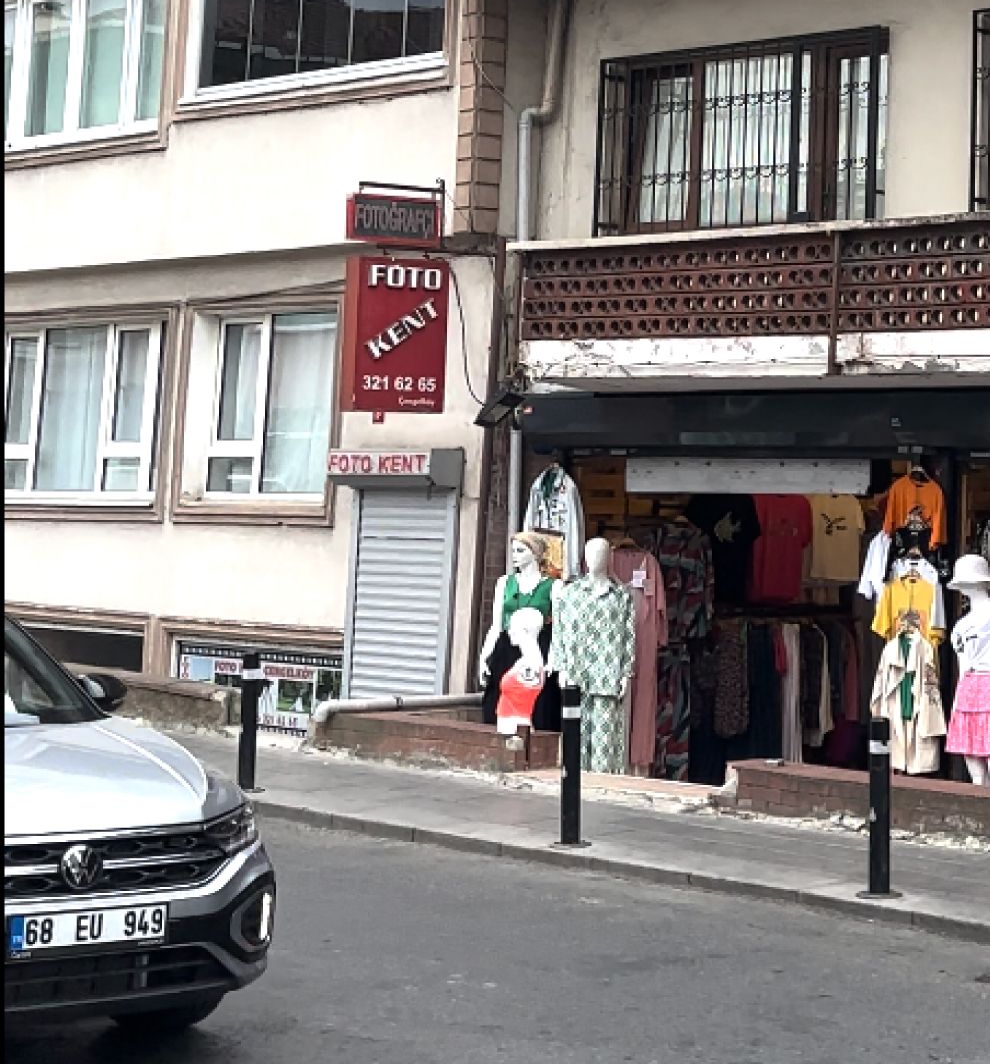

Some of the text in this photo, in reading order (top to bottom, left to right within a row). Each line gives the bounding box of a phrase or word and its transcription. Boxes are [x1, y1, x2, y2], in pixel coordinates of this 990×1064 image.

[368, 264, 442, 290] FOTO
[364, 297, 438, 359] KENT
[363, 374, 437, 393] 321 62 65
[328, 454, 426, 473] FOTO KENT
[26, 908, 163, 945] 68 EU 949
